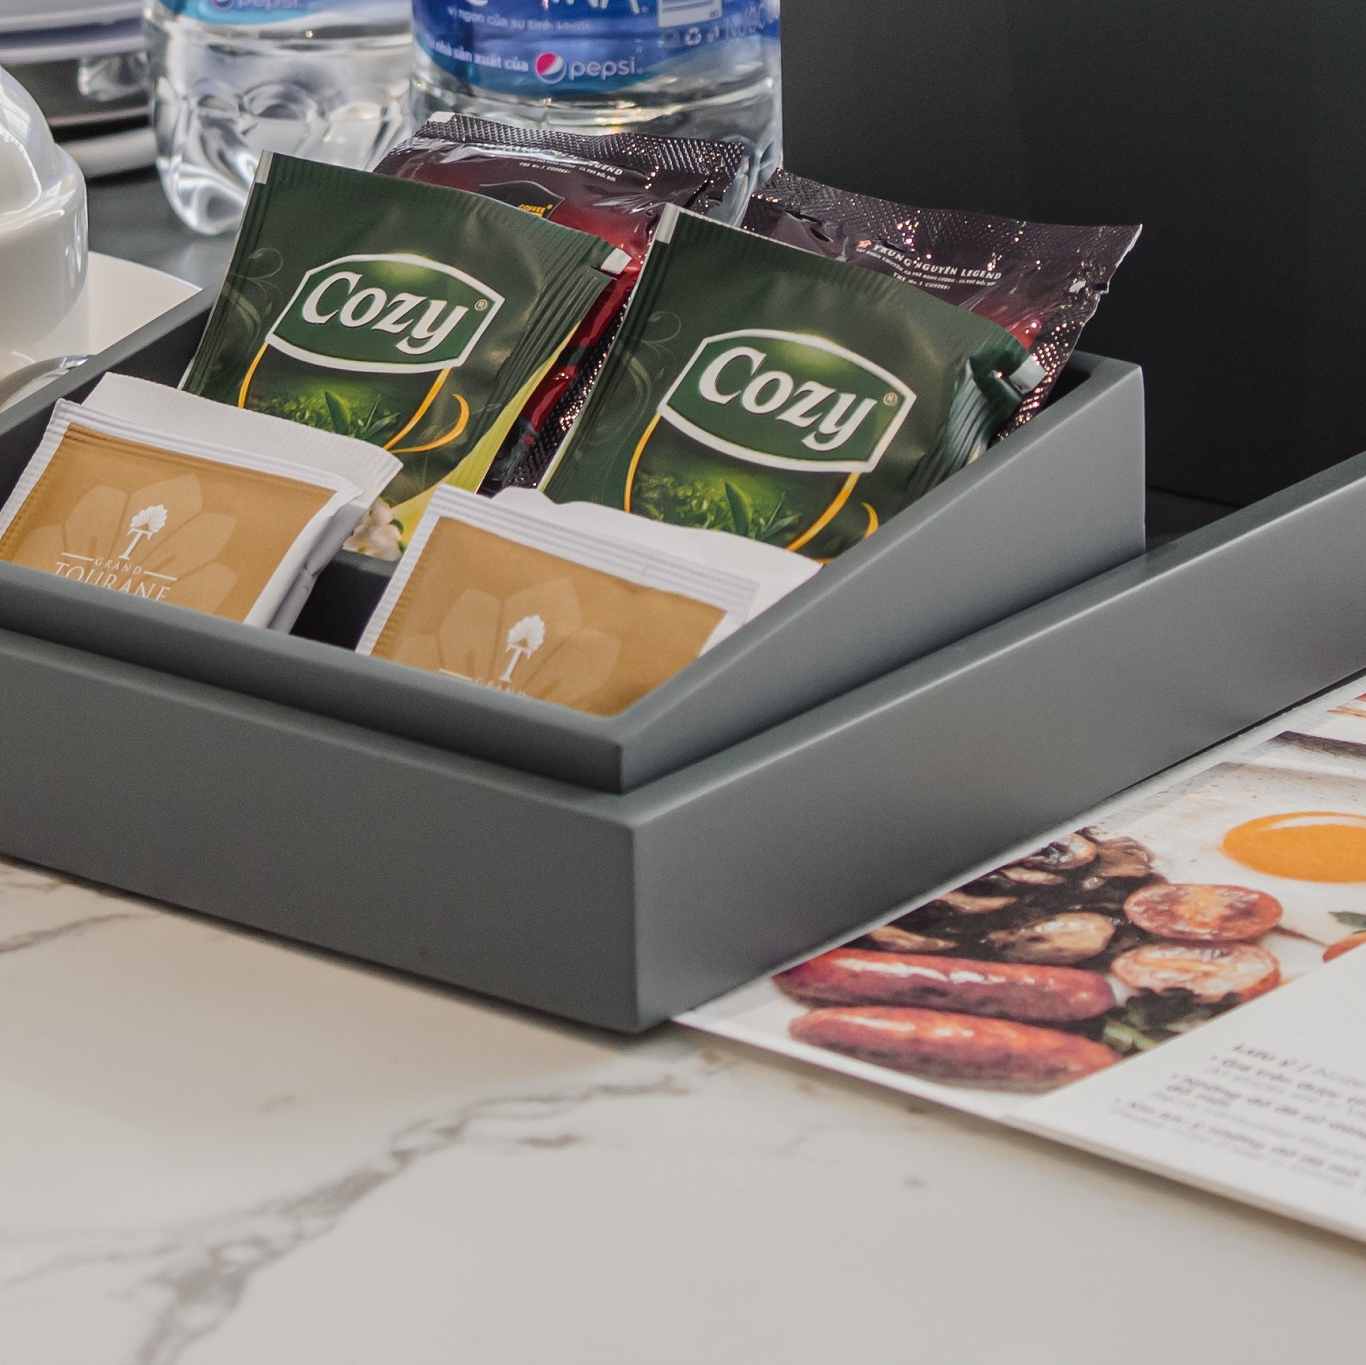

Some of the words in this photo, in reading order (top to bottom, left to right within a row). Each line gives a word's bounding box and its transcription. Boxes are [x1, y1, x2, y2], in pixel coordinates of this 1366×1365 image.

[568, 56, 636, 80] pepsi
[872, 244, 912, 267] TRUNG
[960, 268, 1002, 280] LEGEND
[301, 270, 469, 355] Cozy
[698, 345, 881, 452] Cozy
[93, 556, 143, 576] GRAND
